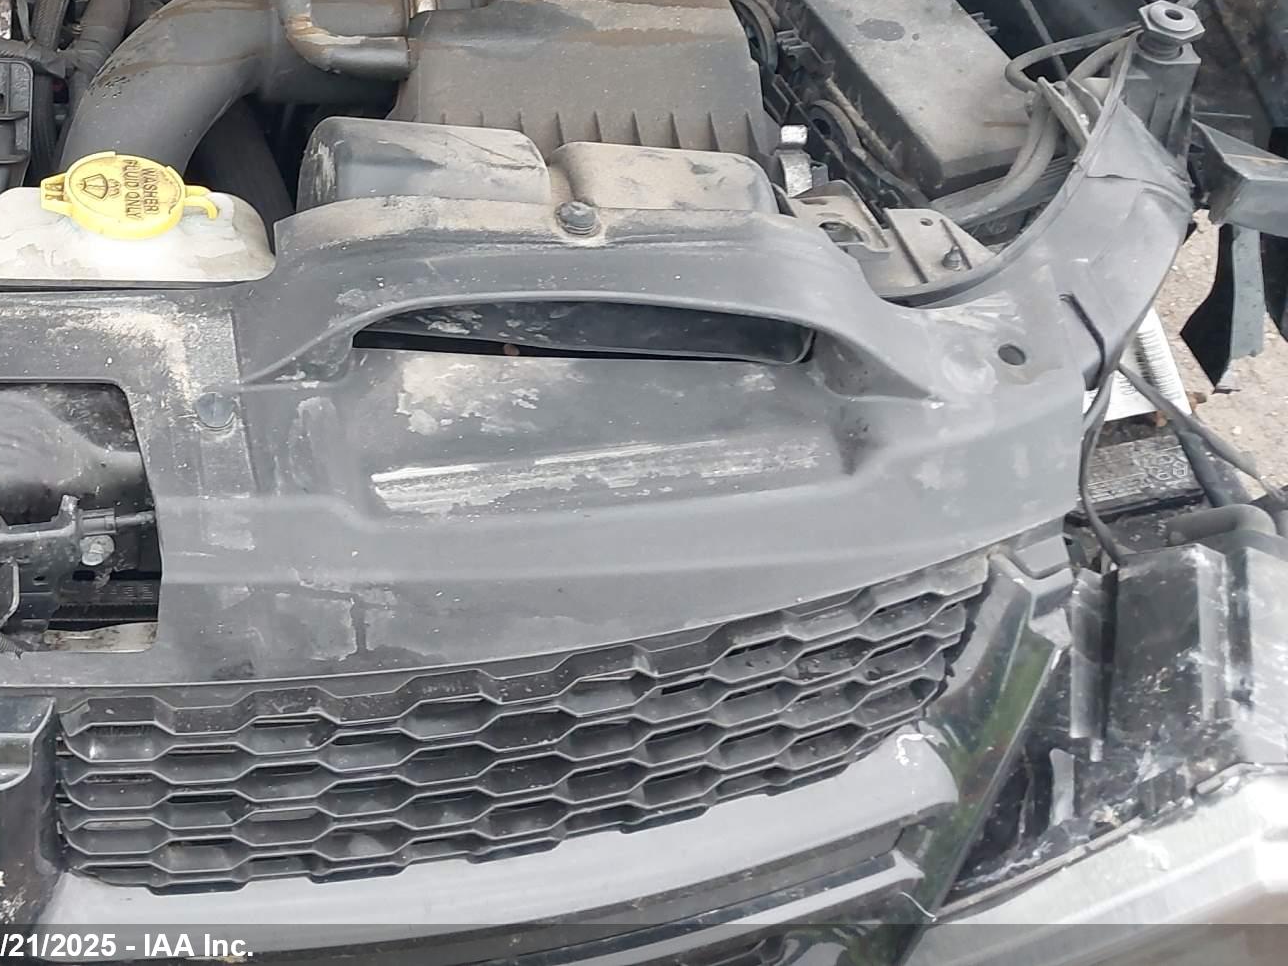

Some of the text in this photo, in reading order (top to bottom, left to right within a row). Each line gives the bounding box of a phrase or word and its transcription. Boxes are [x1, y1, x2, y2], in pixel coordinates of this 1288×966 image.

[123, 159, 143, 221] FLUID ONLY
[141, 167, 160, 215] WASHER
